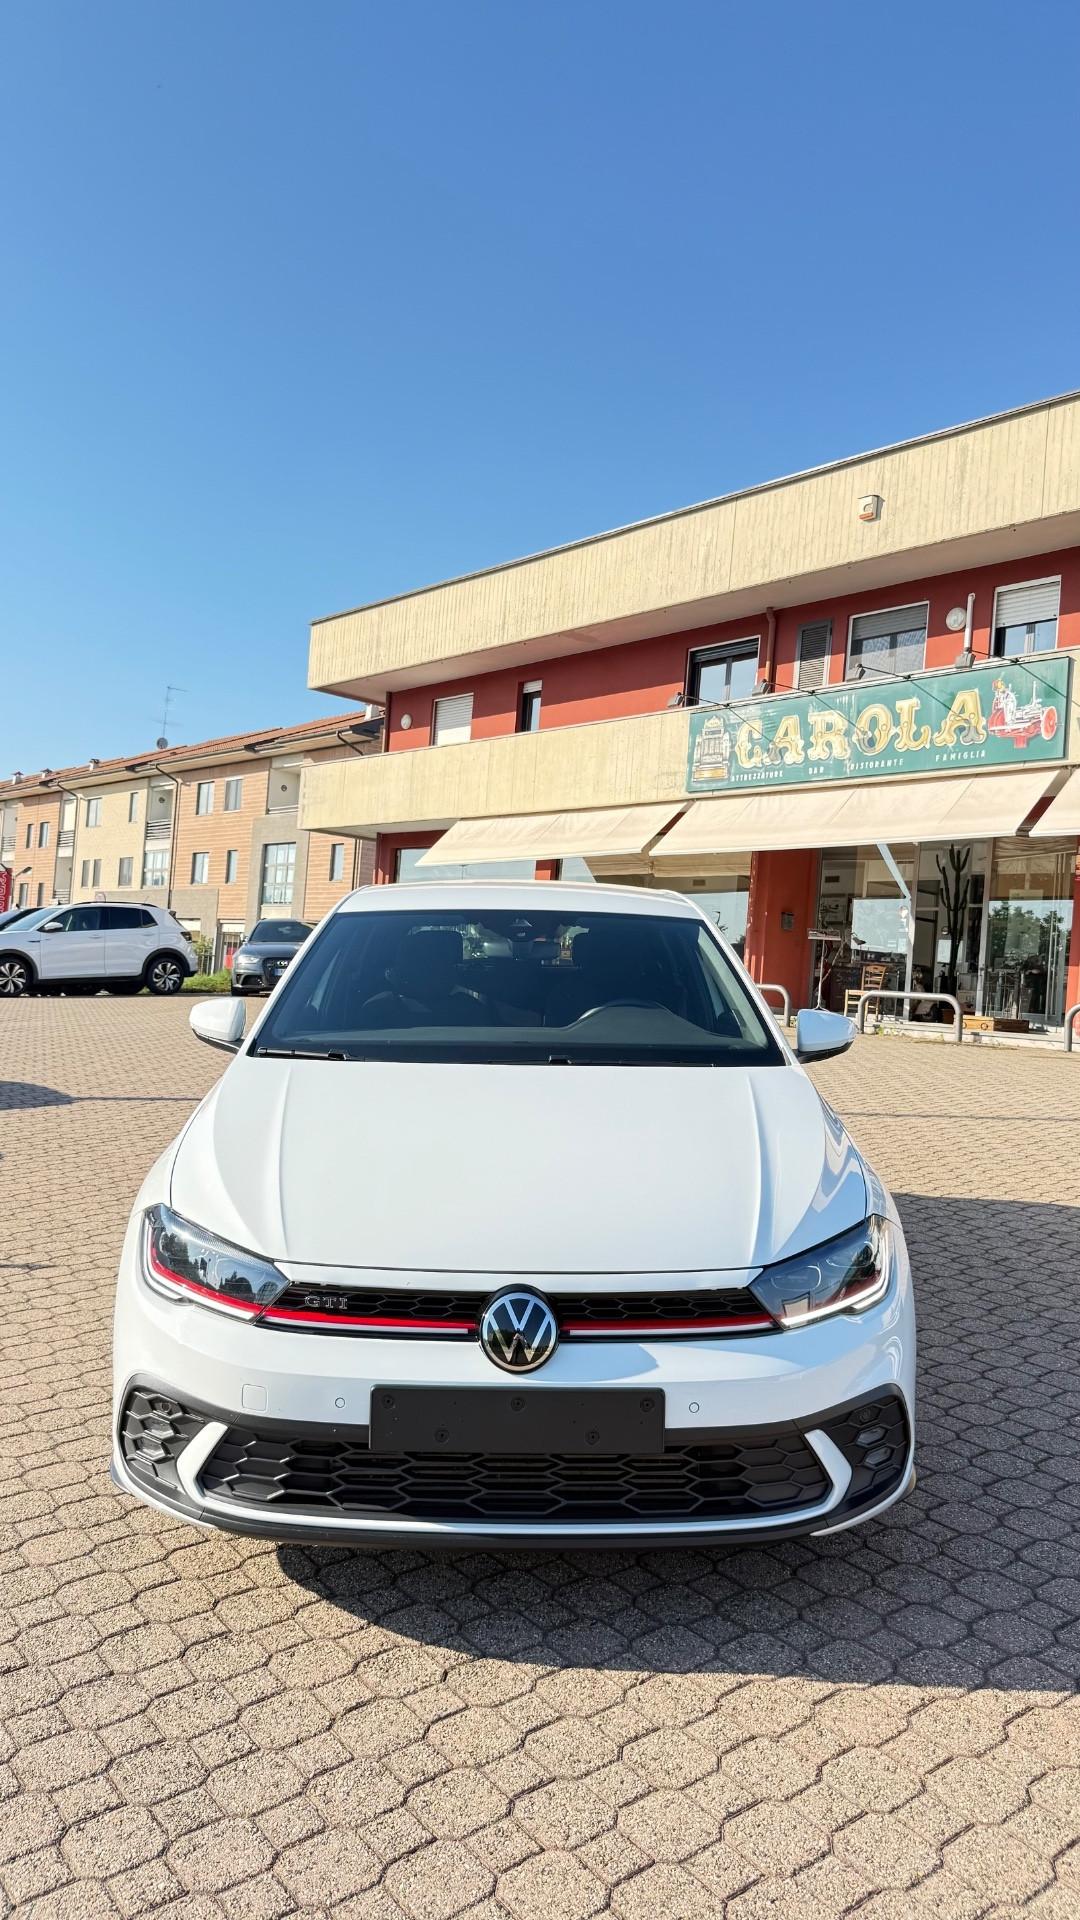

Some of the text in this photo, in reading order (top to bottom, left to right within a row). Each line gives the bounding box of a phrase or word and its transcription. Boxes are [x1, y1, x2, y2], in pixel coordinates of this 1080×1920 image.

[735, 688, 987, 768] CAROLA
[935, 749, 986, 762] FAMIGLIA
[304, 1295, 348, 1310] GTI
